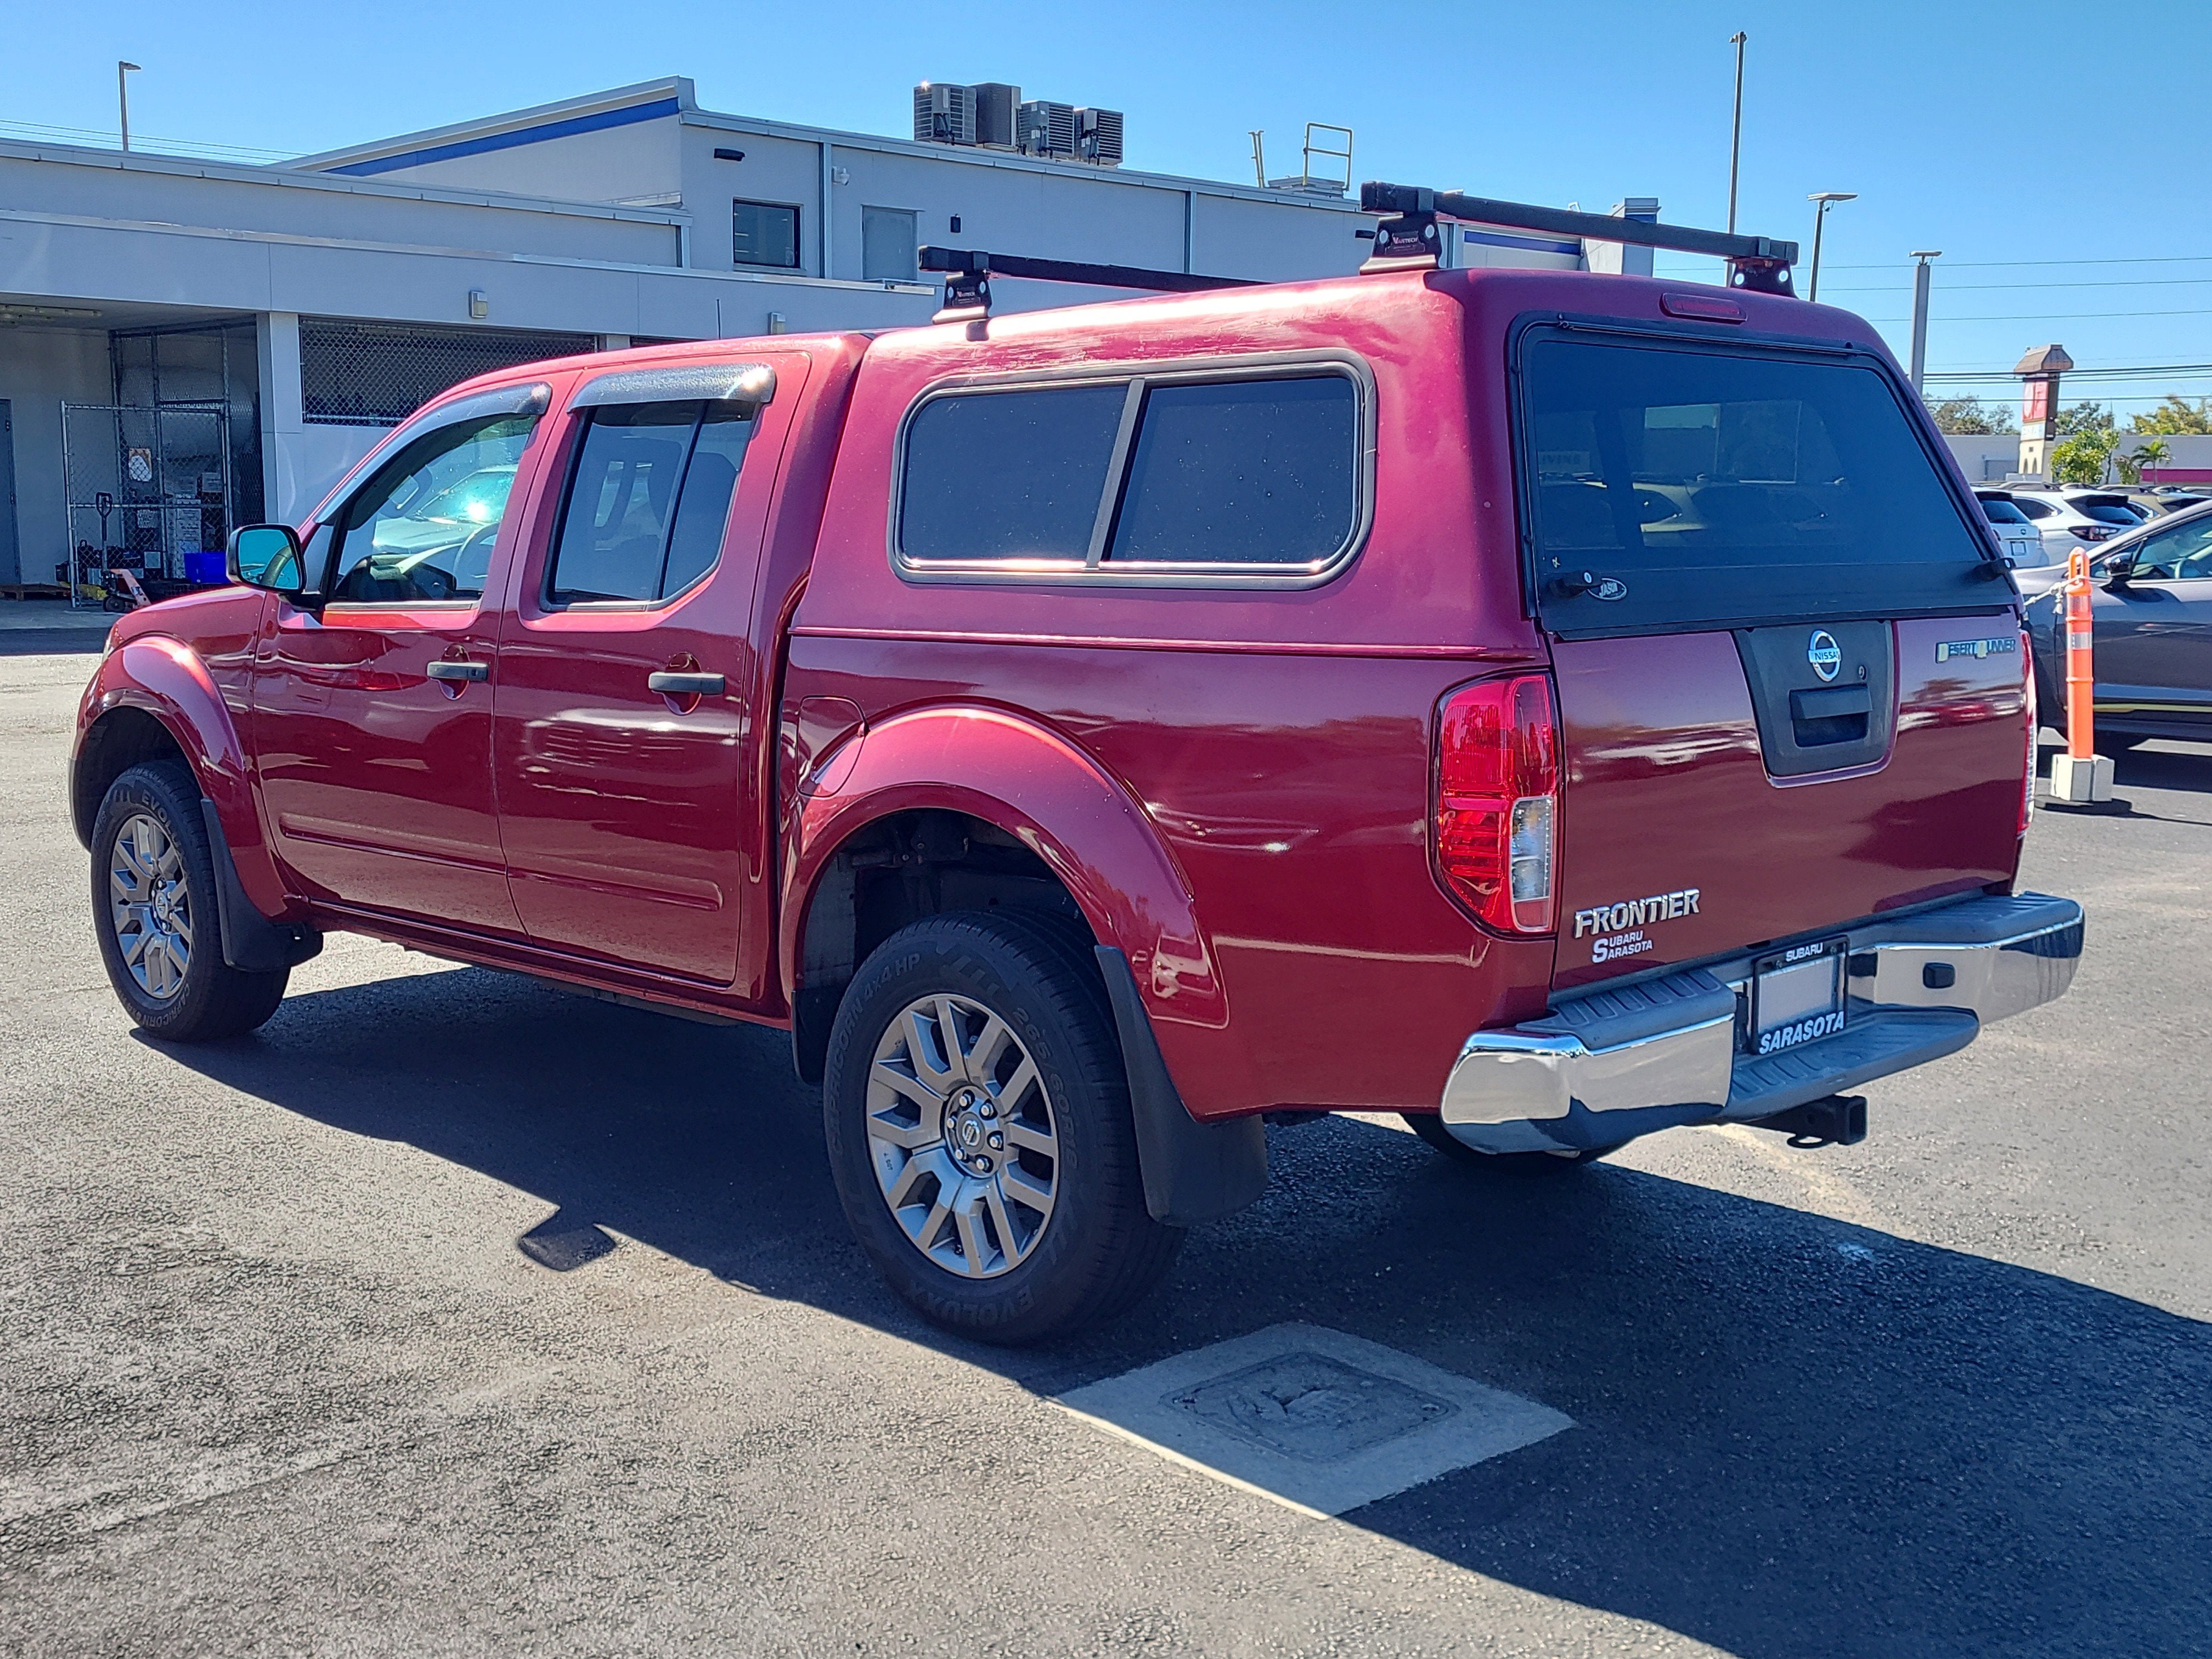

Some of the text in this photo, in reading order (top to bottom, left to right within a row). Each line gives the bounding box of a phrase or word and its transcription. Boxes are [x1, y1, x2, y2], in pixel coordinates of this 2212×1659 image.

[1574, 888, 1701, 939] FRONTIER
[1785, 943, 1824, 962] SUBARU
[1758, 1011, 1845, 1055] SARASOTA
